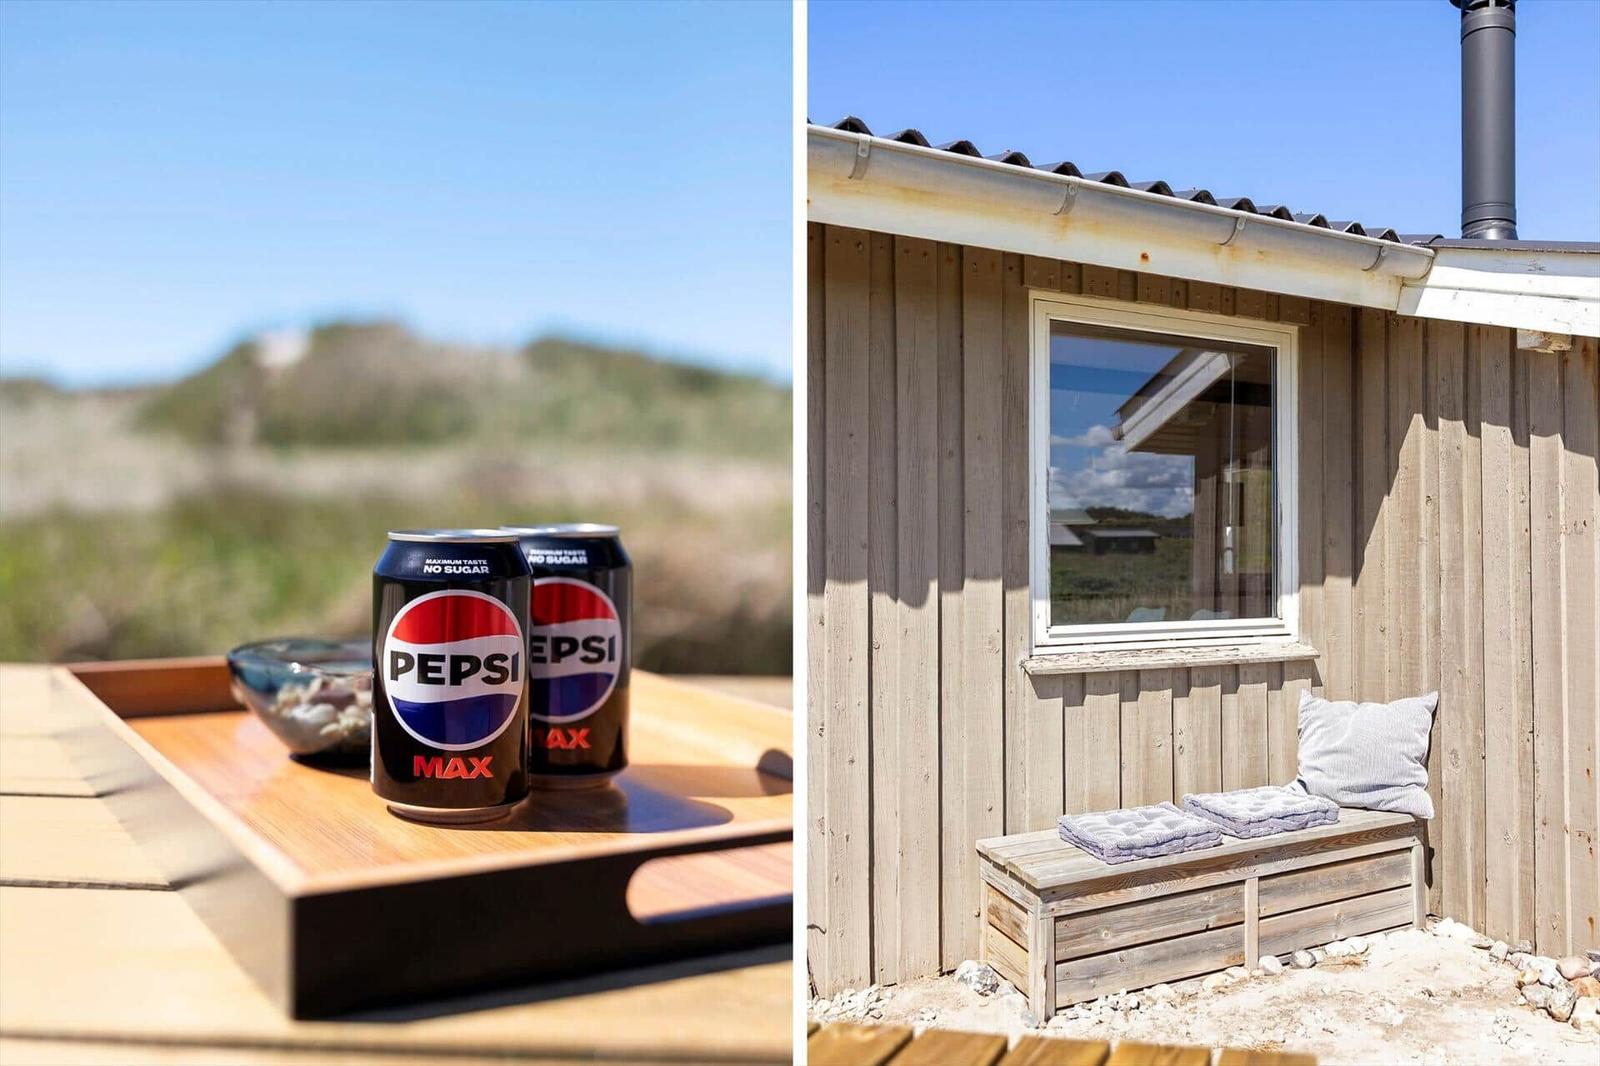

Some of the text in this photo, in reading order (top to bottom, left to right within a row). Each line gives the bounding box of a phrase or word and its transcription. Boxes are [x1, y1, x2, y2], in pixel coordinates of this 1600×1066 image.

[423, 565, 489, 574] NO SUGAR
[545, 556, 588, 564] SUGAR
[531, 635, 616, 664] EPSI
[389, 650, 520, 686] PEPSI
[413, 755, 494, 779] MAX
